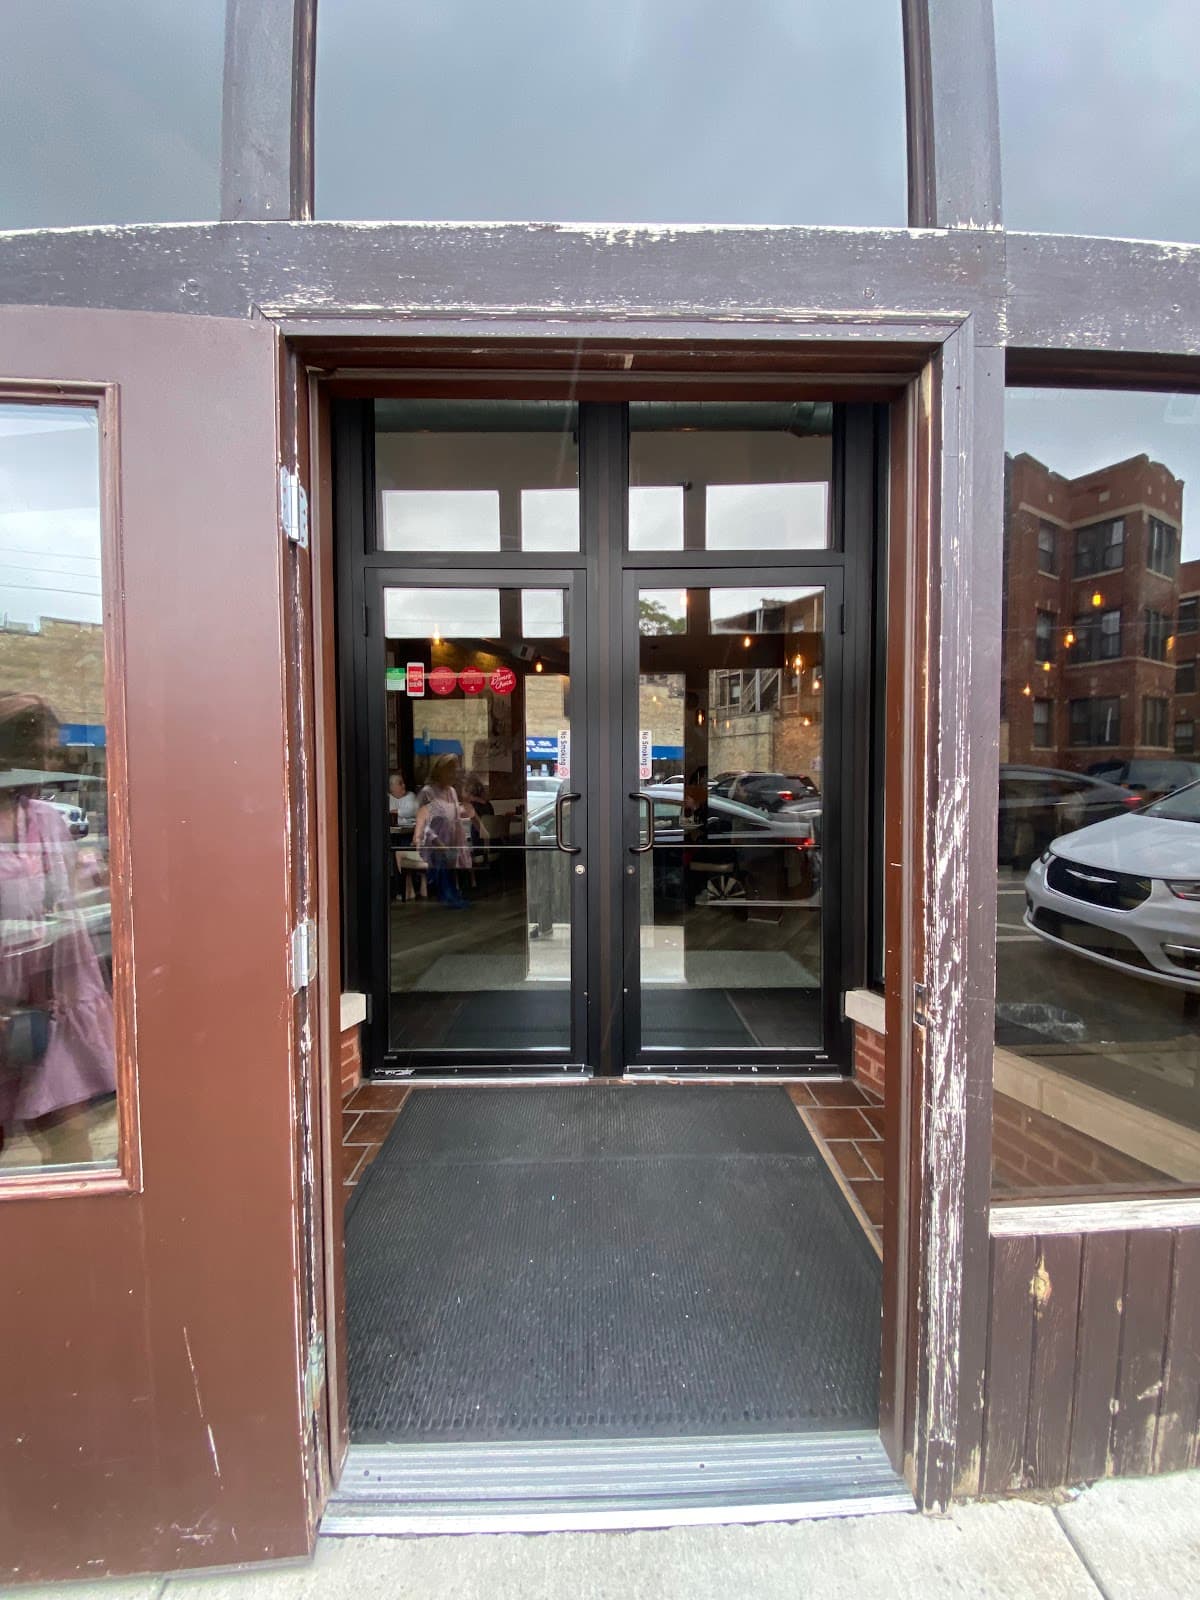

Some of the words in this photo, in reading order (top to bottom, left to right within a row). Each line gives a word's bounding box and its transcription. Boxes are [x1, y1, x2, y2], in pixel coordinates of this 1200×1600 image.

[560, 731, 568, 739] No
[641, 731, 649, 740] No
[559, 740, 568, 766] Smoking
[640, 741, 649, 766] Smoking
